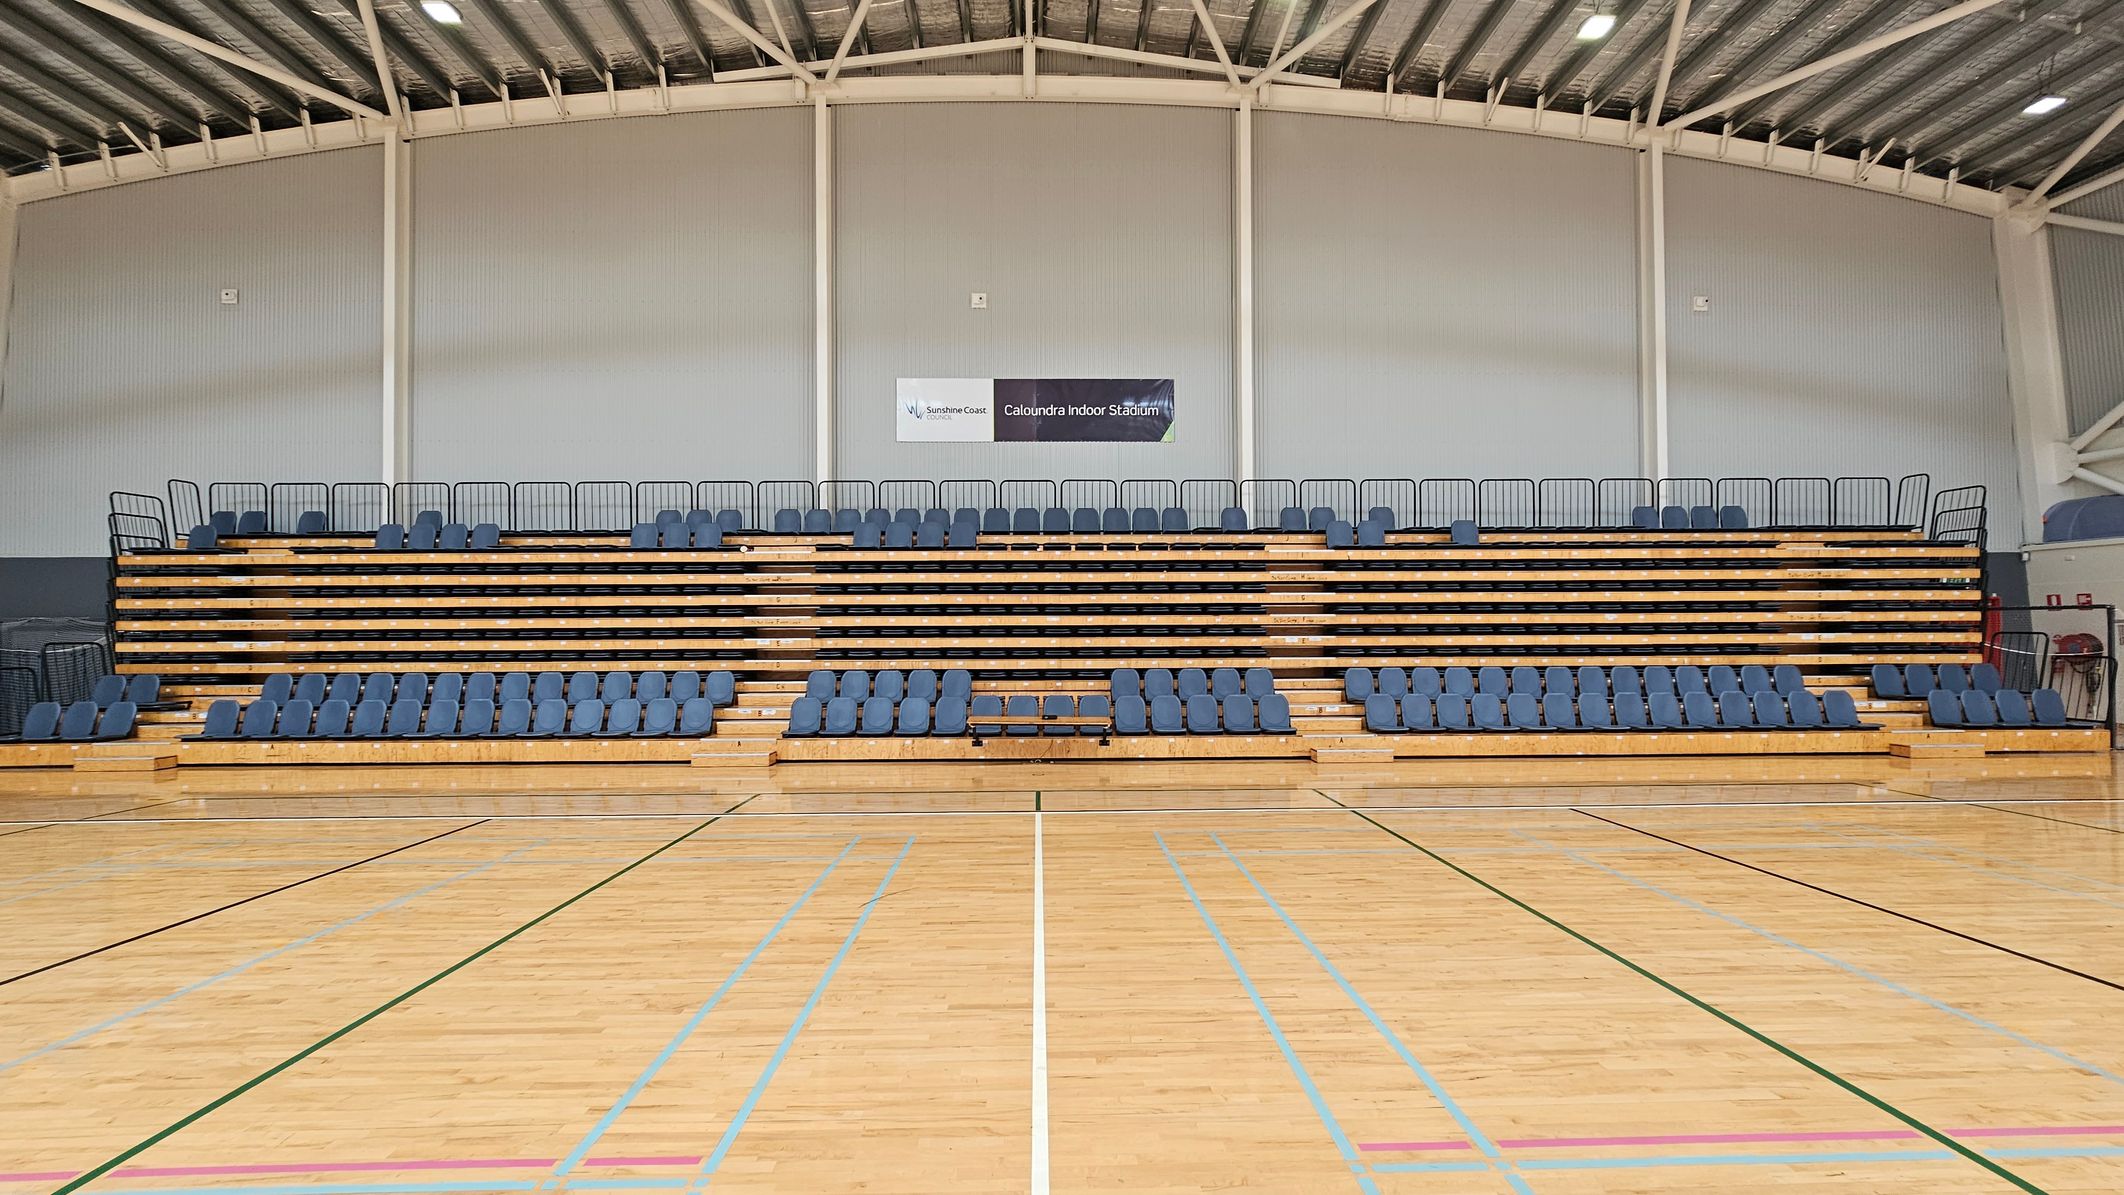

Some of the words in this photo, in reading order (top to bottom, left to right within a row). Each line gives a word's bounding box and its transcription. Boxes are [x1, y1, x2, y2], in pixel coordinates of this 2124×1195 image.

[926, 406, 963, 414] Sunshine
[963, 406, 987, 414] Coast
[1004, 404, 1066, 416] Caloundra
[1068, 404, 1106, 416] Indoor
[1109, 404, 1159, 416] Stadium
